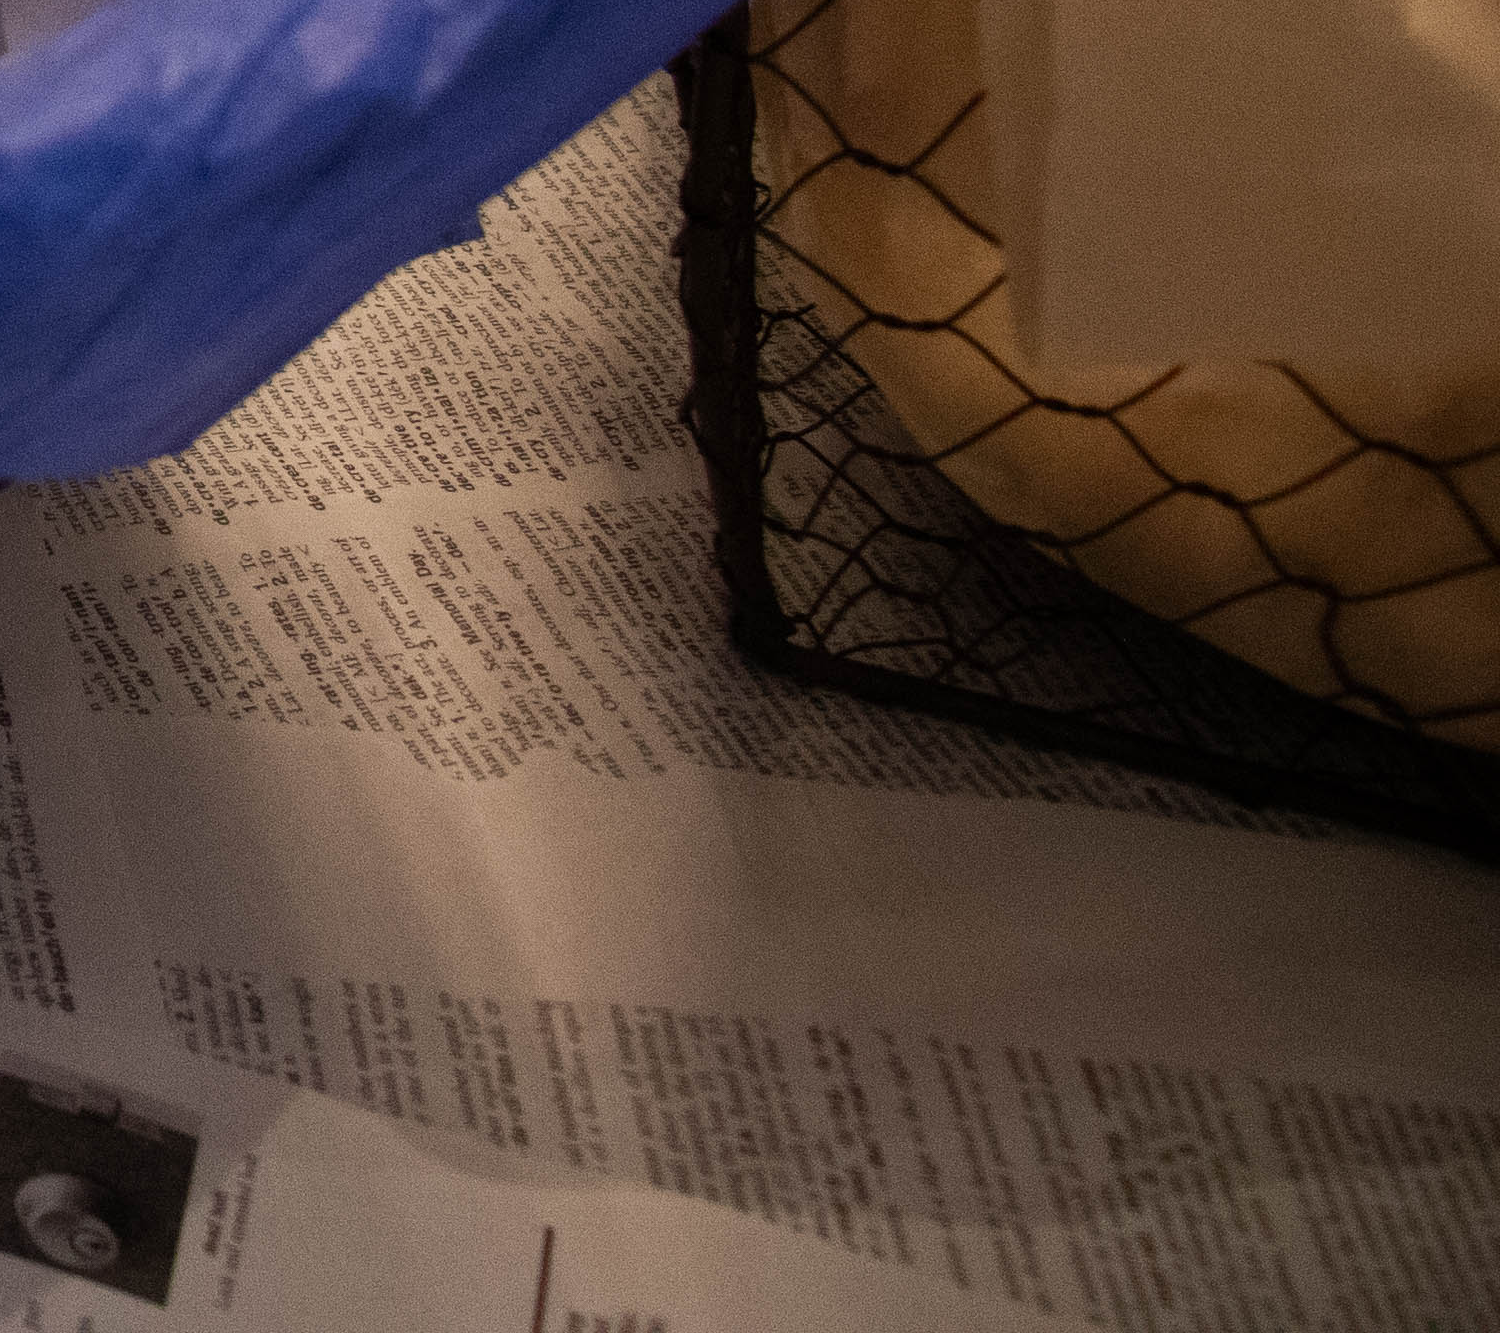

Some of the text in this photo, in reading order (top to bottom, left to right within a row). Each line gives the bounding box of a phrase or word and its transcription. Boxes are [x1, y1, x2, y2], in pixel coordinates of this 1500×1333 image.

[365, 312, 393, 345] force
[410, 320, 448, 367] abolish
[344, 374, 385, 430] decision.
[403, 372, 439, 419] having
[455, 389, 490, 434] reduce
[333, 422, 368, 460] giving
[530, 377, 598, 466] proclamation
[172, 479, 203, 516] down
[211, 478, 240, 511] With
[406, 548, 433, 578] Day.
[412, 523, 457, 582] decorate
[367, 552, 409, 607] emblem
[375, 594, 419, 650] process,
[424, 573, 482, 647] Memorial
